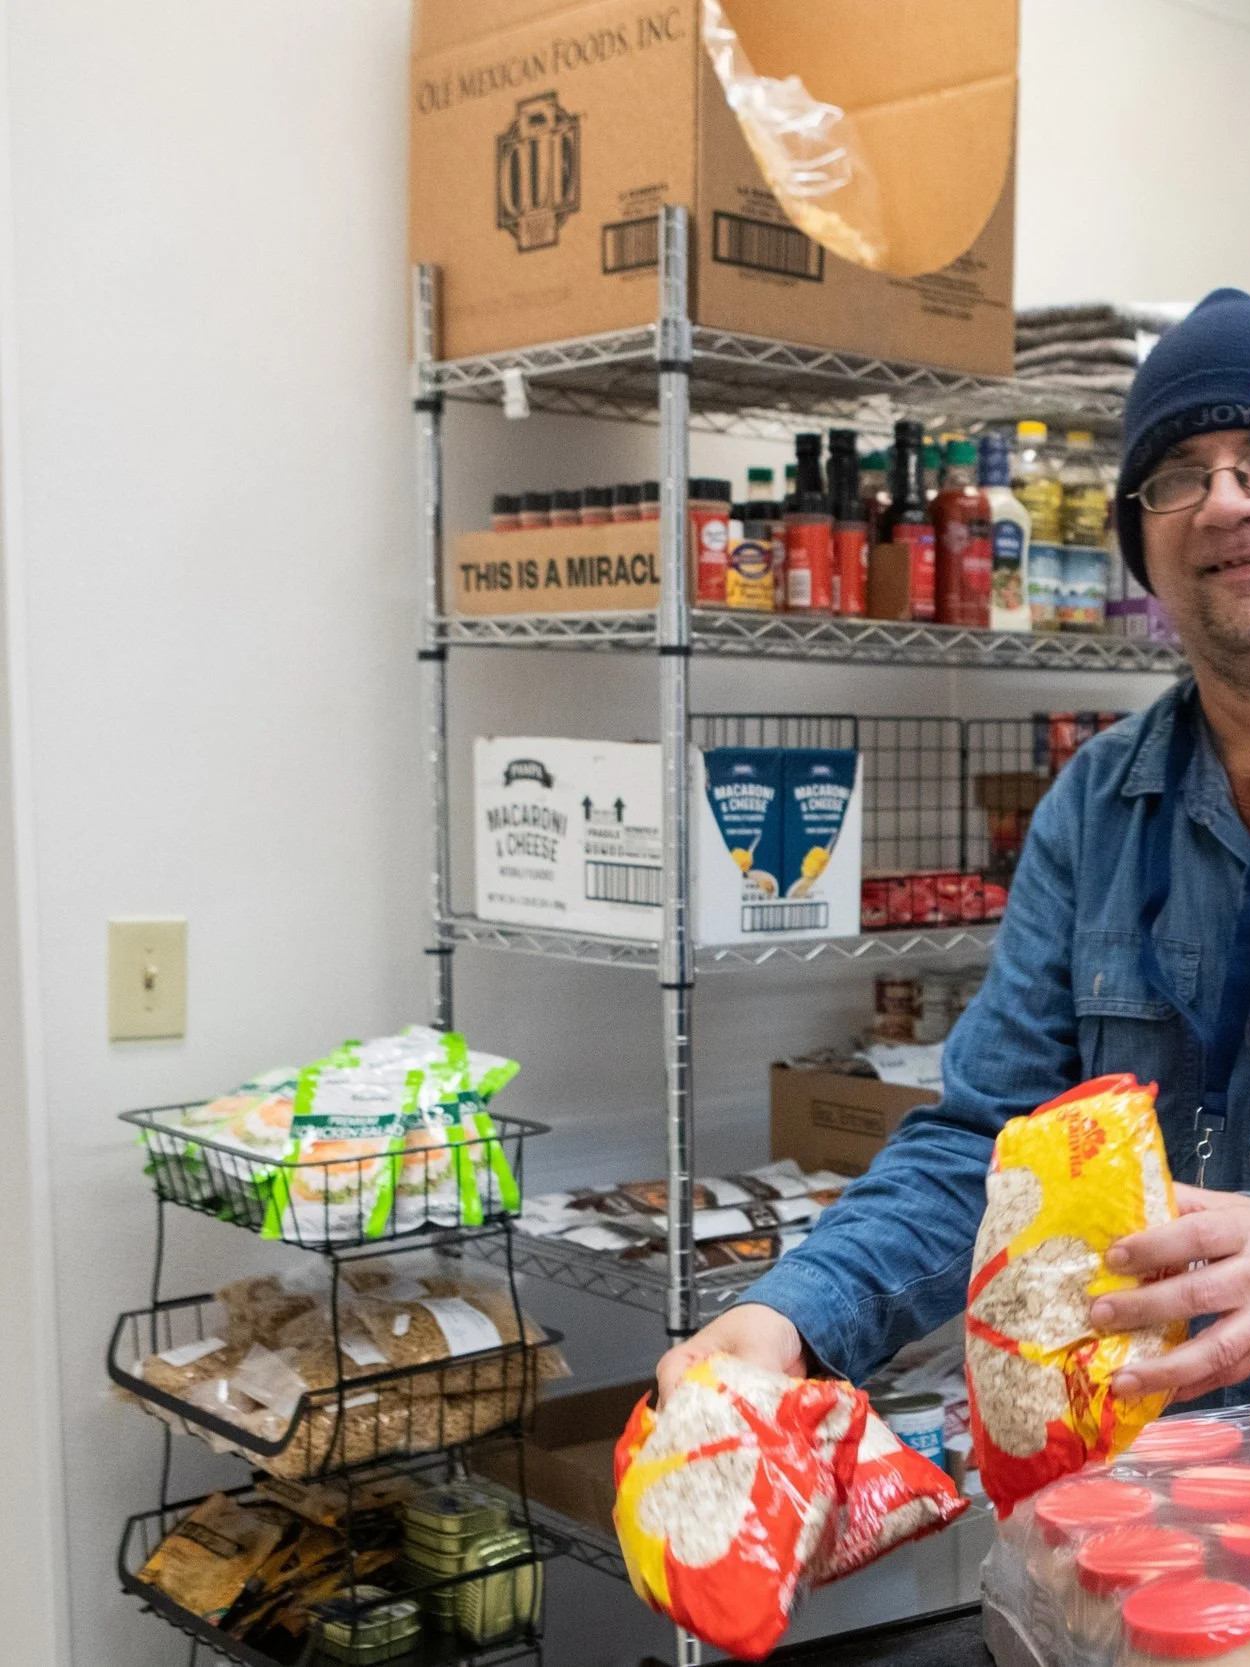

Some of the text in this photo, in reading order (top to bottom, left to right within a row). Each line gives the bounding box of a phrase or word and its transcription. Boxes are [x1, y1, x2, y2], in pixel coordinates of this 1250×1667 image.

[456, 51, 548, 101] MEXICAN
[459, 560, 512, 592] THIS
[517, 558, 539, 590] IS
[544, 558, 564, 589] A
[713, 783, 775, 801] MACARONI
[794, 784, 852, 801] MACARONI
[729, 799, 769, 814] CHEESE
[808, 799, 844, 813] CHEESE
[487, 804, 568, 839] MACARONI
[506, 832, 559, 863] CHEESE
[326, 1115, 380, 1128] PREMIUM
[357, 1122, 404, 1138] SALAD
[910, 1432, 939, 1450] SEA
